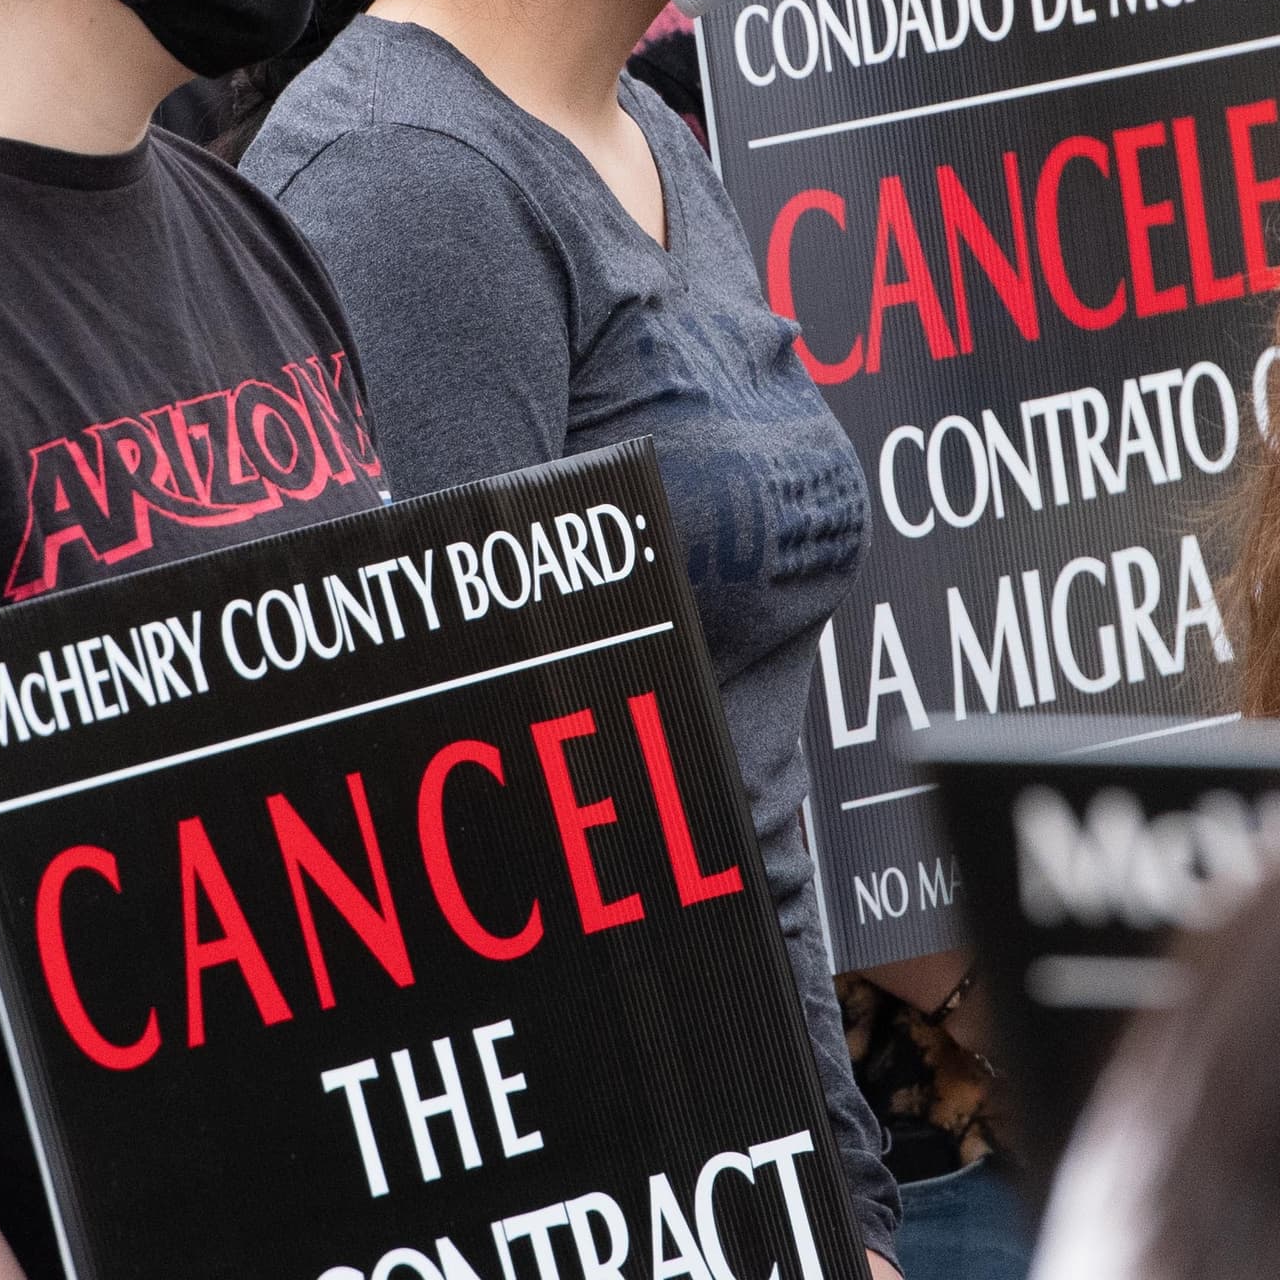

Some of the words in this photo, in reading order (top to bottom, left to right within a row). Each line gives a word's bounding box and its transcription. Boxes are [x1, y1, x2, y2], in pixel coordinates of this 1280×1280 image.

[879, 361, 1239, 537] CONTRATO
[222, 547, 440, 680] COUNTY
[445, 503, 655, 621] BOARD:
[820, 602, 930, 750] LA
[947, 534, 1235, 722] MIGRA
[36, 692, 744, 1070] CANCEL
[854, 866, 910, 925] NO
[320, 1018, 544, 1198] THE
